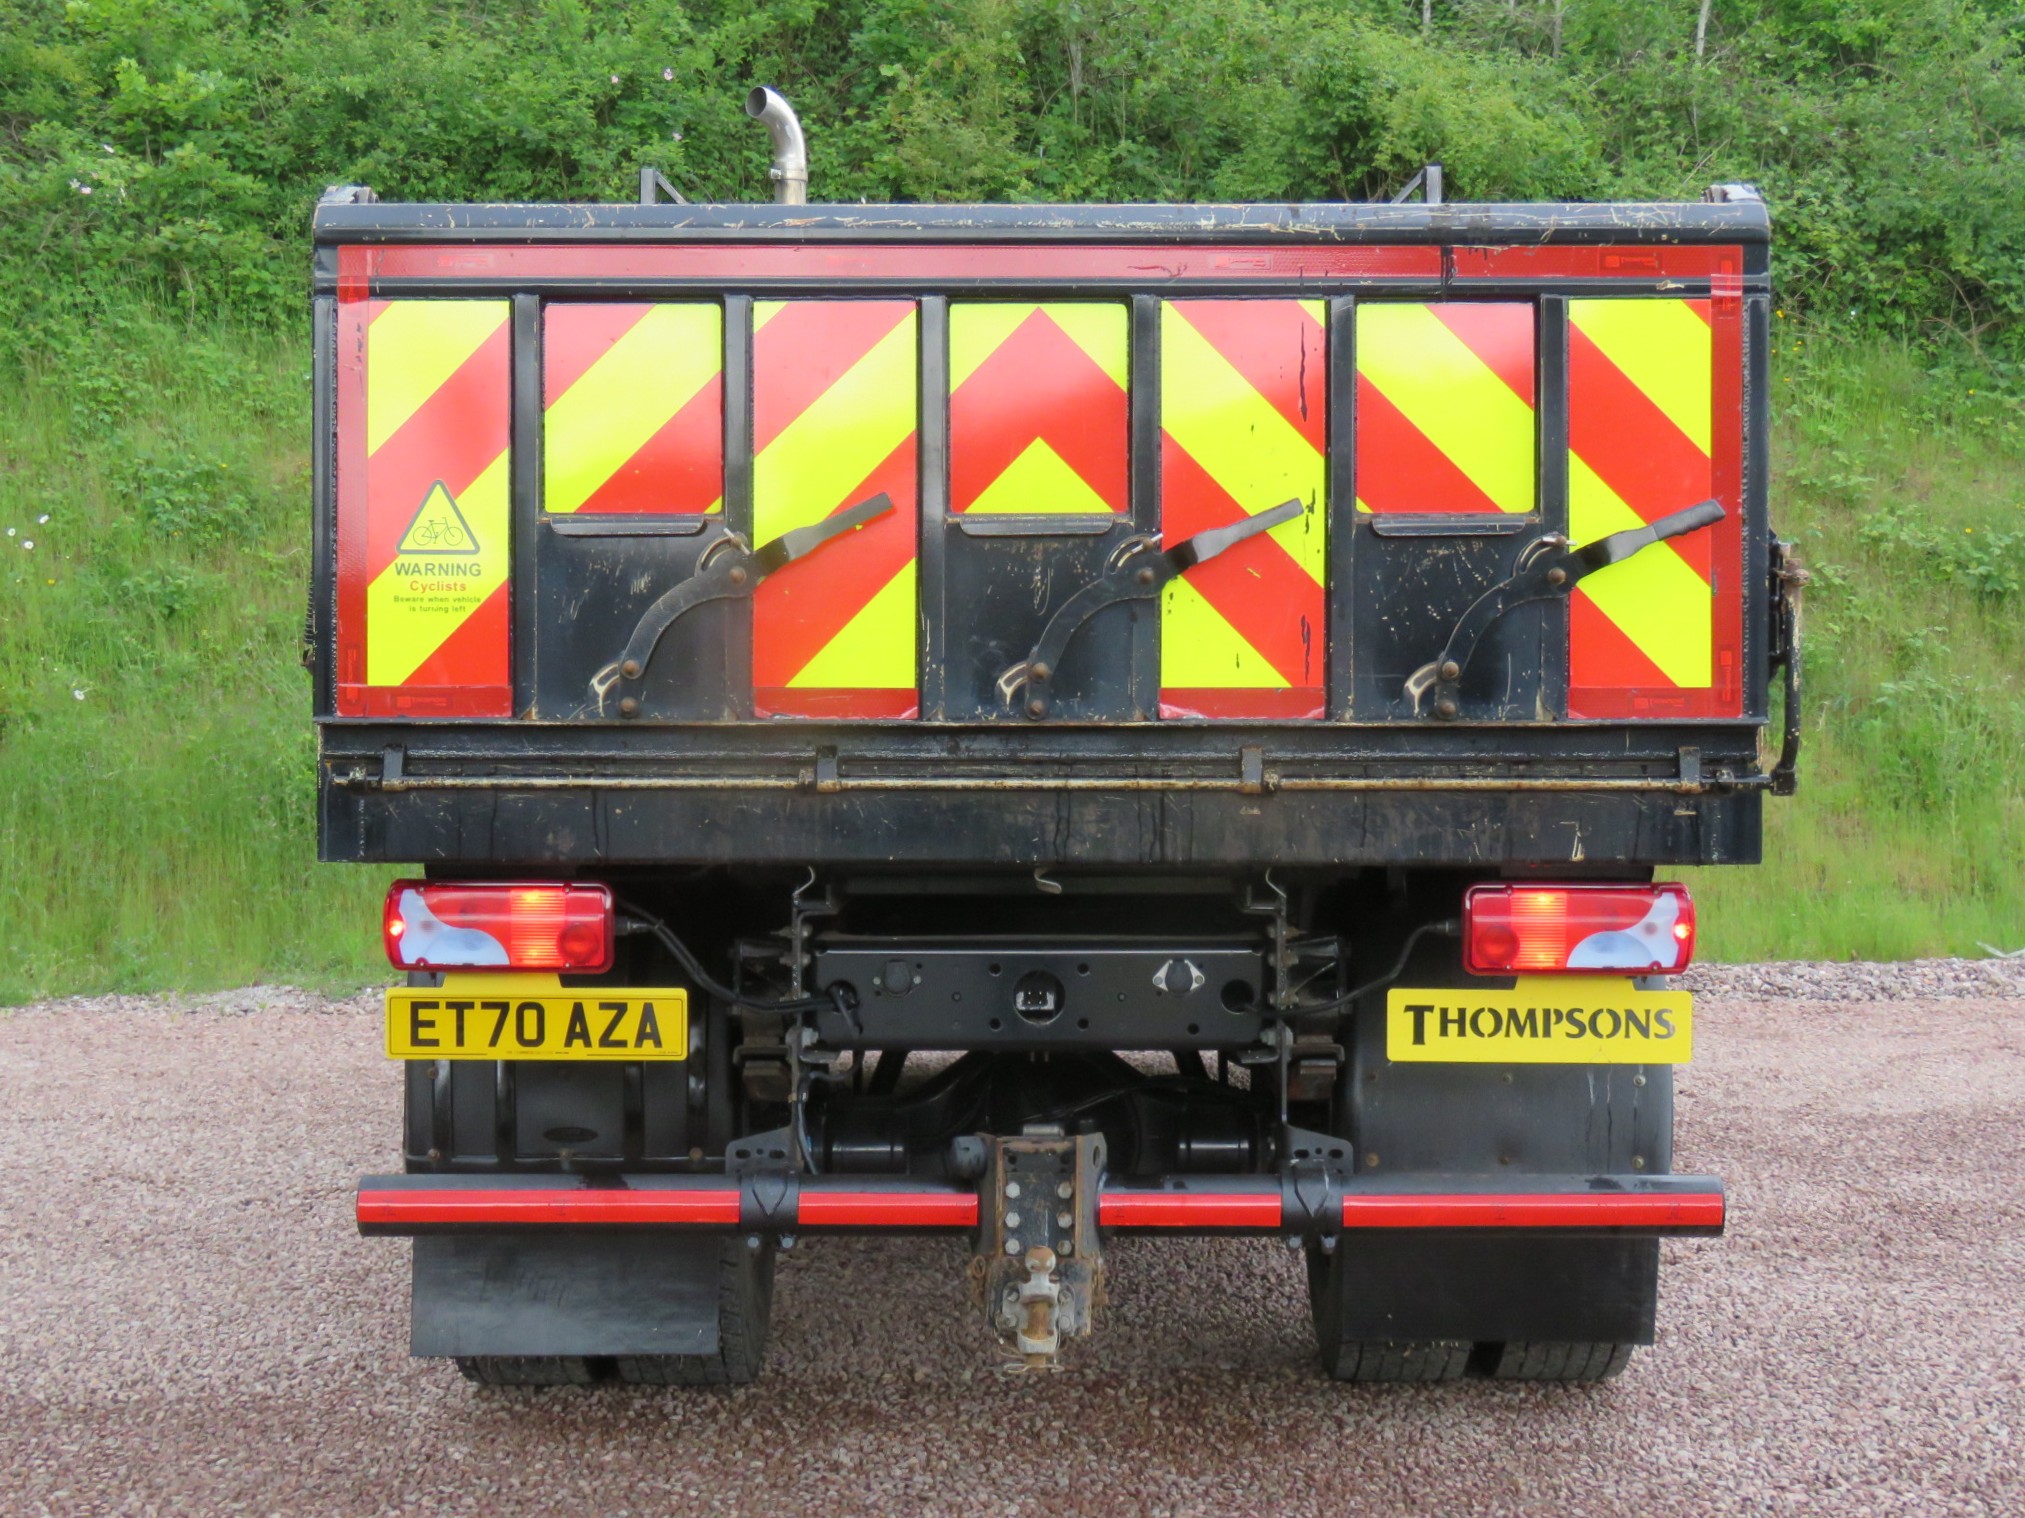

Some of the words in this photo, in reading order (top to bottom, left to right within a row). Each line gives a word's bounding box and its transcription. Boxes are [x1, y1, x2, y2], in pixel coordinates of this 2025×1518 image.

[395, 562, 481, 577] WARNING
[409, 580, 467, 593] Cyclists
[393, 595, 425, 603] Beware
[427, 595, 450, 603] when
[452, 595, 482, 603] vehicle
[419, 605, 450, 614] turning
[409, 1001, 545, 1048] ET70
[564, 1002, 662, 1048] AZA
[1404, 1005, 1676, 1045] THOMPSONS
